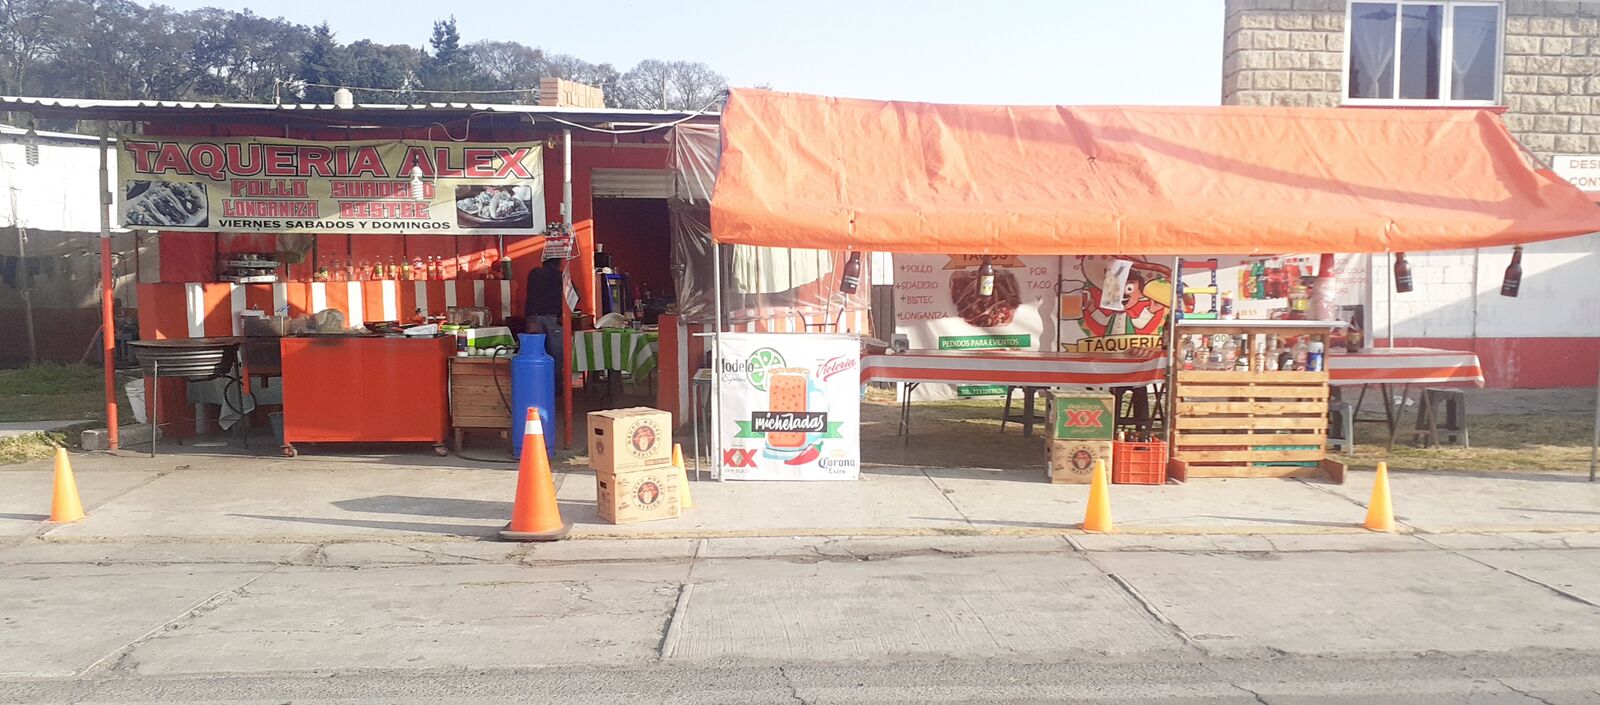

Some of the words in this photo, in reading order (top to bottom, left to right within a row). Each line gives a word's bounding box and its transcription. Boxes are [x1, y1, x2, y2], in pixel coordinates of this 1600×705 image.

[124, 141, 389, 181] TAQUERIA
[397, 145, 534, 179] ALEX
[1570, 160, 1600, 169] DES
[230, 179, 308, 198] POLLO
[329, 180, 436, 199] SUADEO
[1569, 177, 1600, 186] CON
[222, 199, 319, 218] LONGANIZA
[338, 201, 431, 220] BISTEC
[219, 220, 281, 229] VIERNES
[285, 220, 354, 229] SABADOS
[359, 221, 368, 229] Y
[372, 221, 450, 230] DOMINGOS
[1030, 267, 1047, 276] POR
[1027, 281, 1052, 290] TACO
[942, 340, 970, 348] PEDIDOS
[989, 338, 1020, 346] EVENTOS
[1084, 337, 1164, 352] TAQUERIA
[816, 354, 857, 382] Victoria
[755, 412, 824, 431] micheladas
[1064, 410, 1104, 427] XX
[723, 448, 758, 467] XX
[818, 457, 856, 469] Corona
